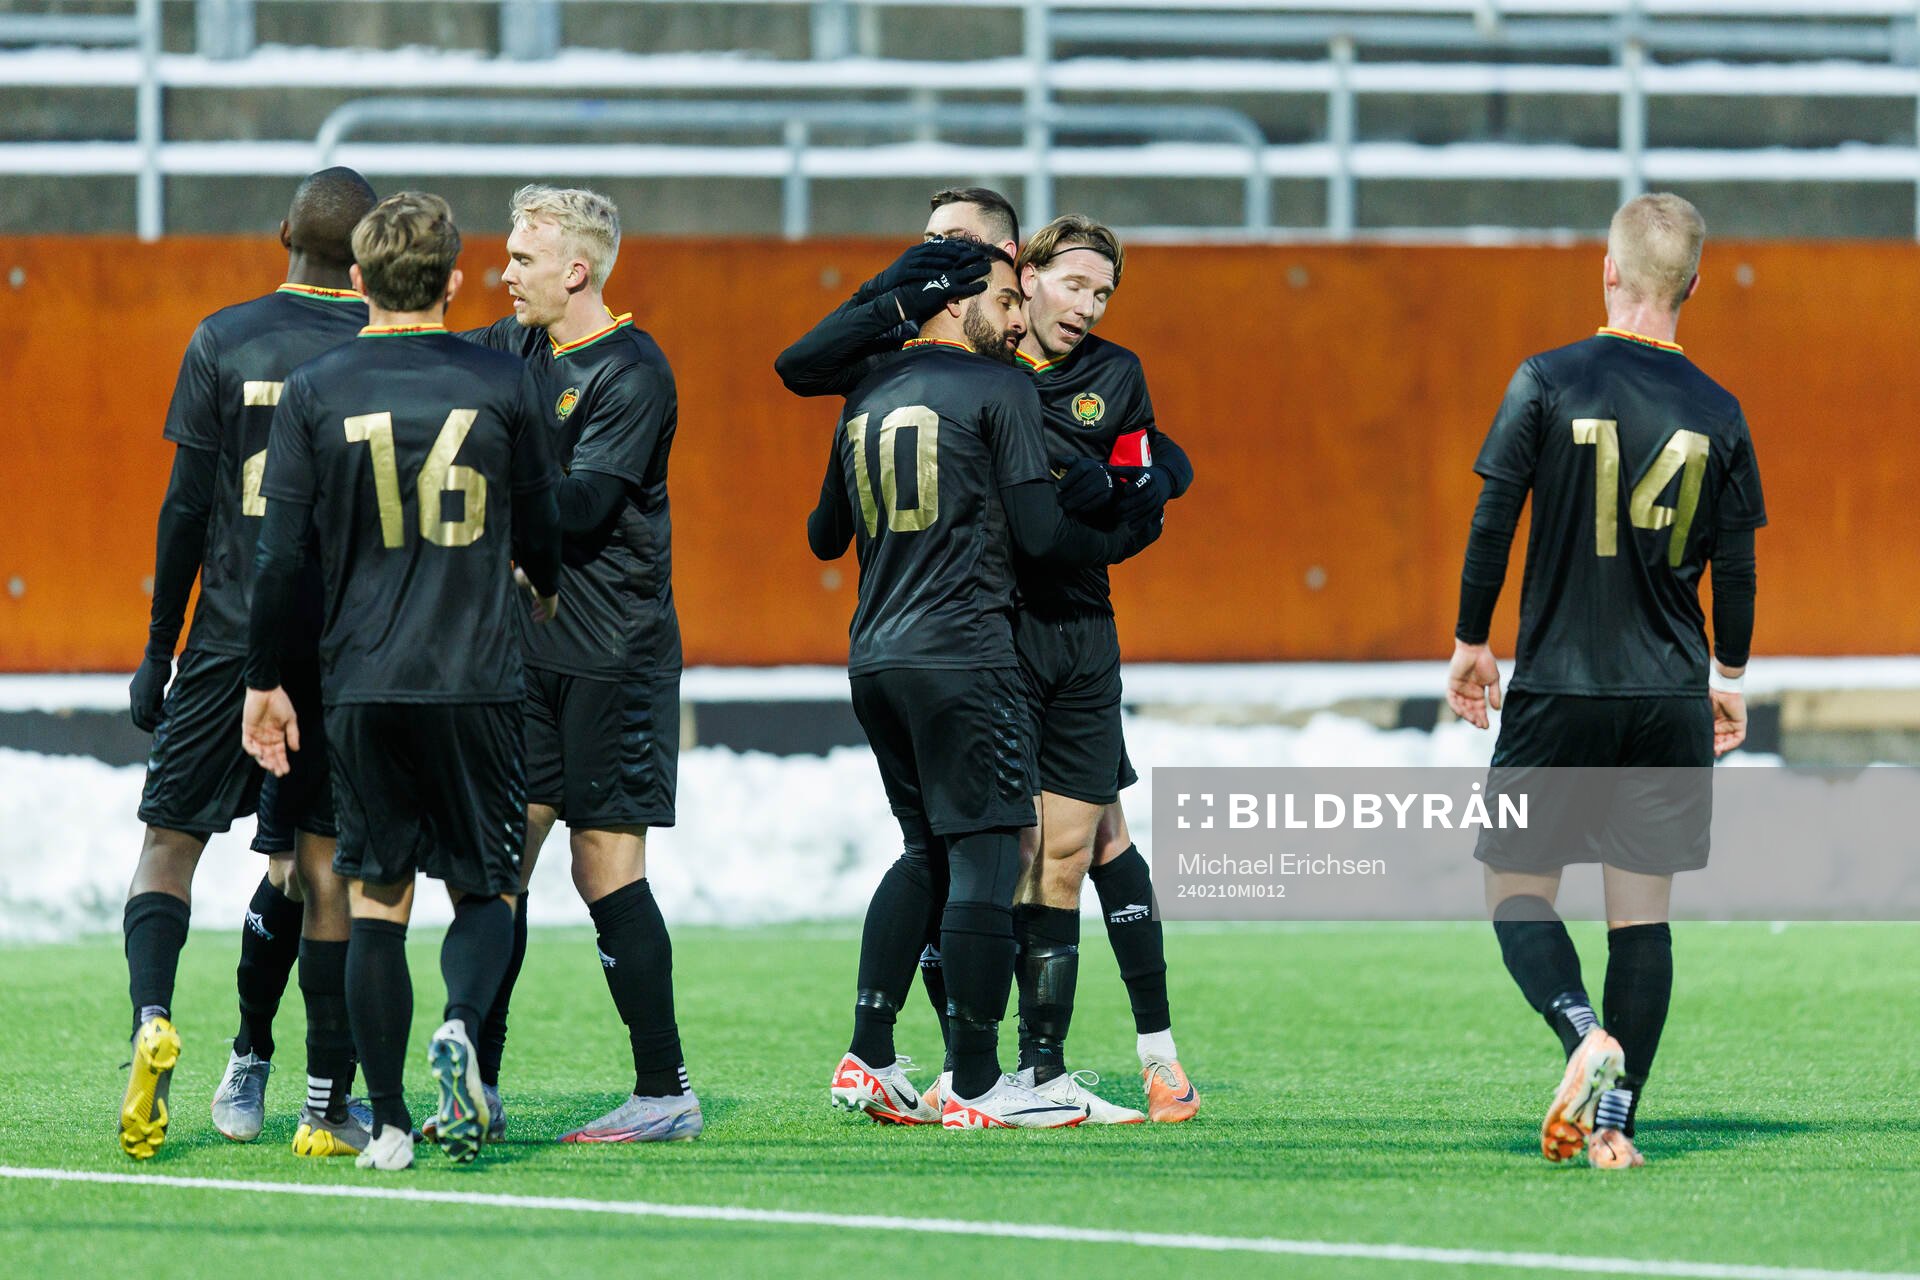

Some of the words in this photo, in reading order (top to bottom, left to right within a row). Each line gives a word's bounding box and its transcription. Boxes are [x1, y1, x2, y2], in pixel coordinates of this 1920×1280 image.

[344, 408, 487, 549] 16
[846, 405, 939, 539] 10
[1572, 418, 1710, 568] 14
[1110, 910, 1149, 923] SELECT
